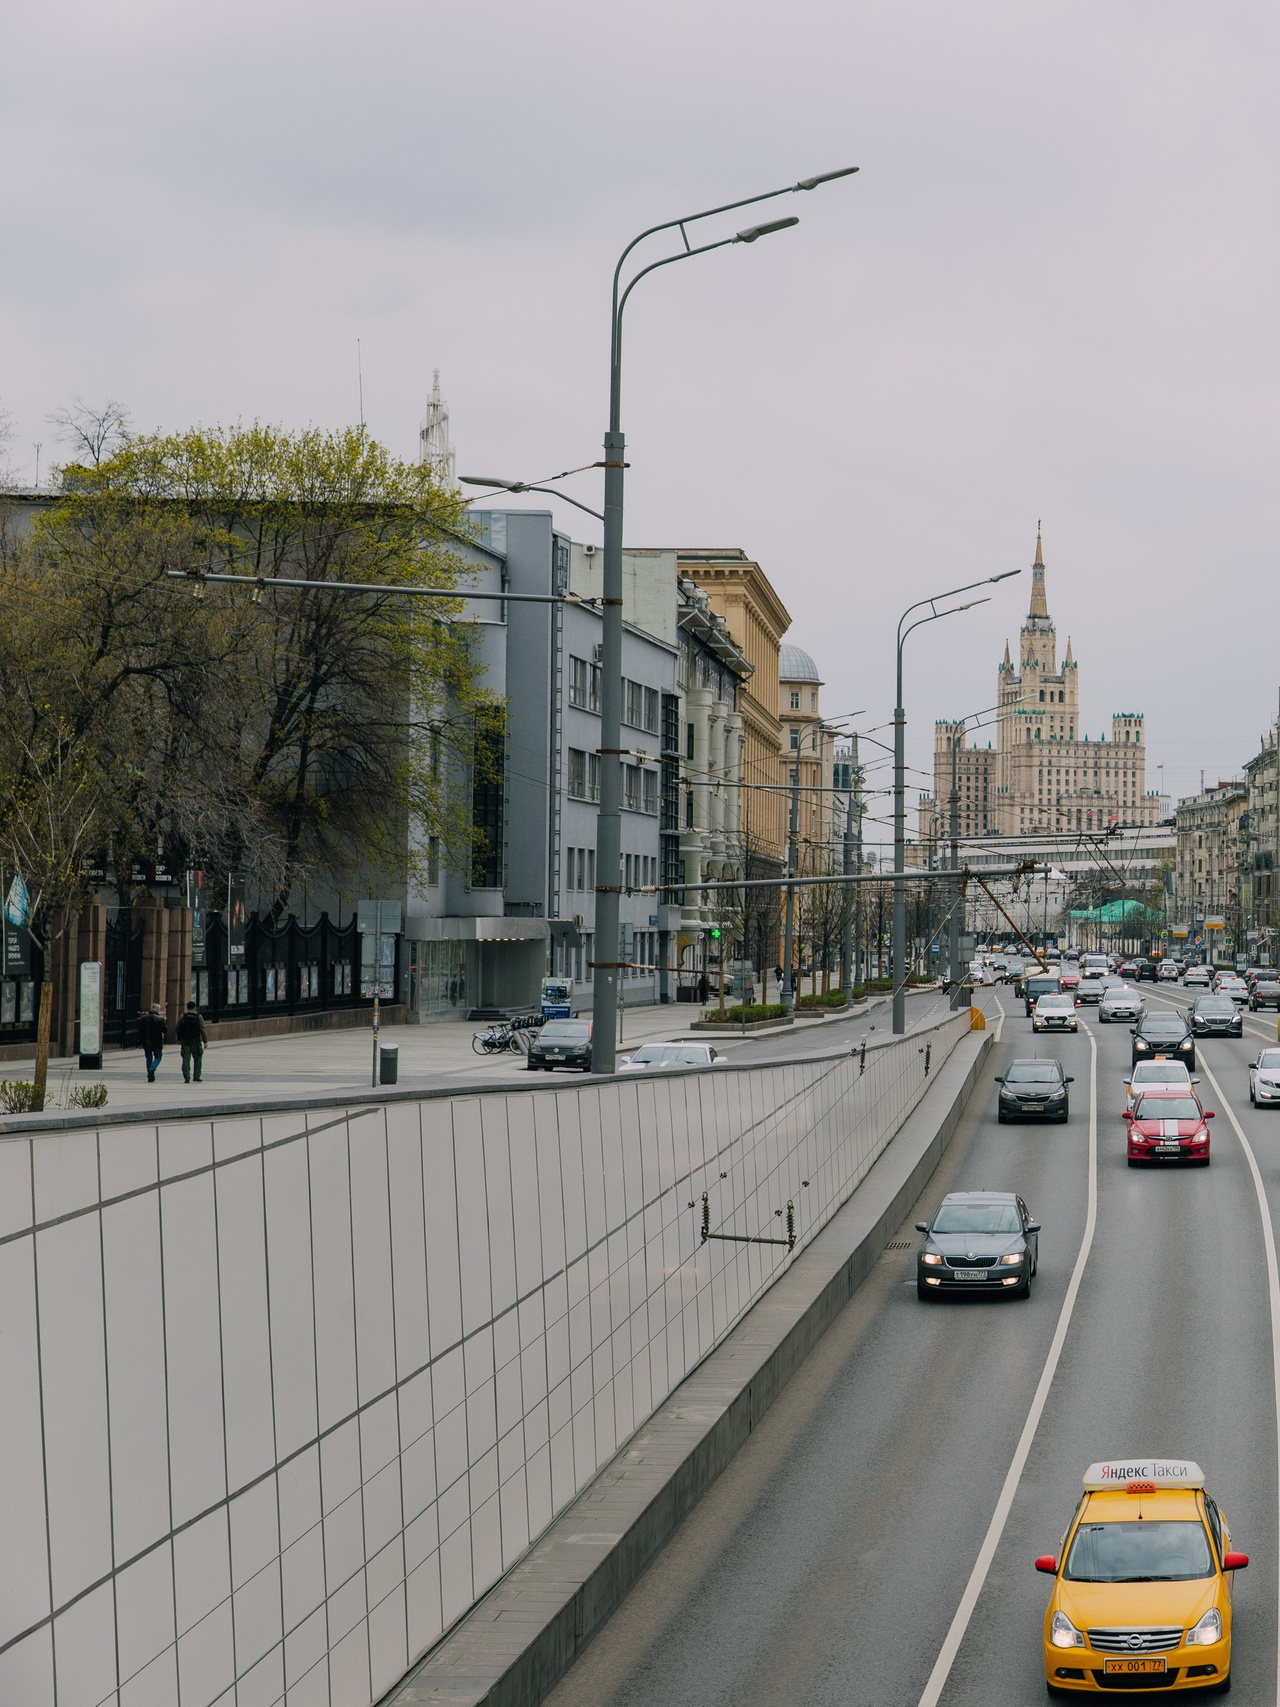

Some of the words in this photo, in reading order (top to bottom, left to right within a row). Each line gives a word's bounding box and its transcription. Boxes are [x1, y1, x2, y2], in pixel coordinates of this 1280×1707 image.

[1101, 1465, 1148, 1480] Яндекс
[1151, 1463, 1188, 1477] Такси
[1127, 1661, 1146, 1671] 001
